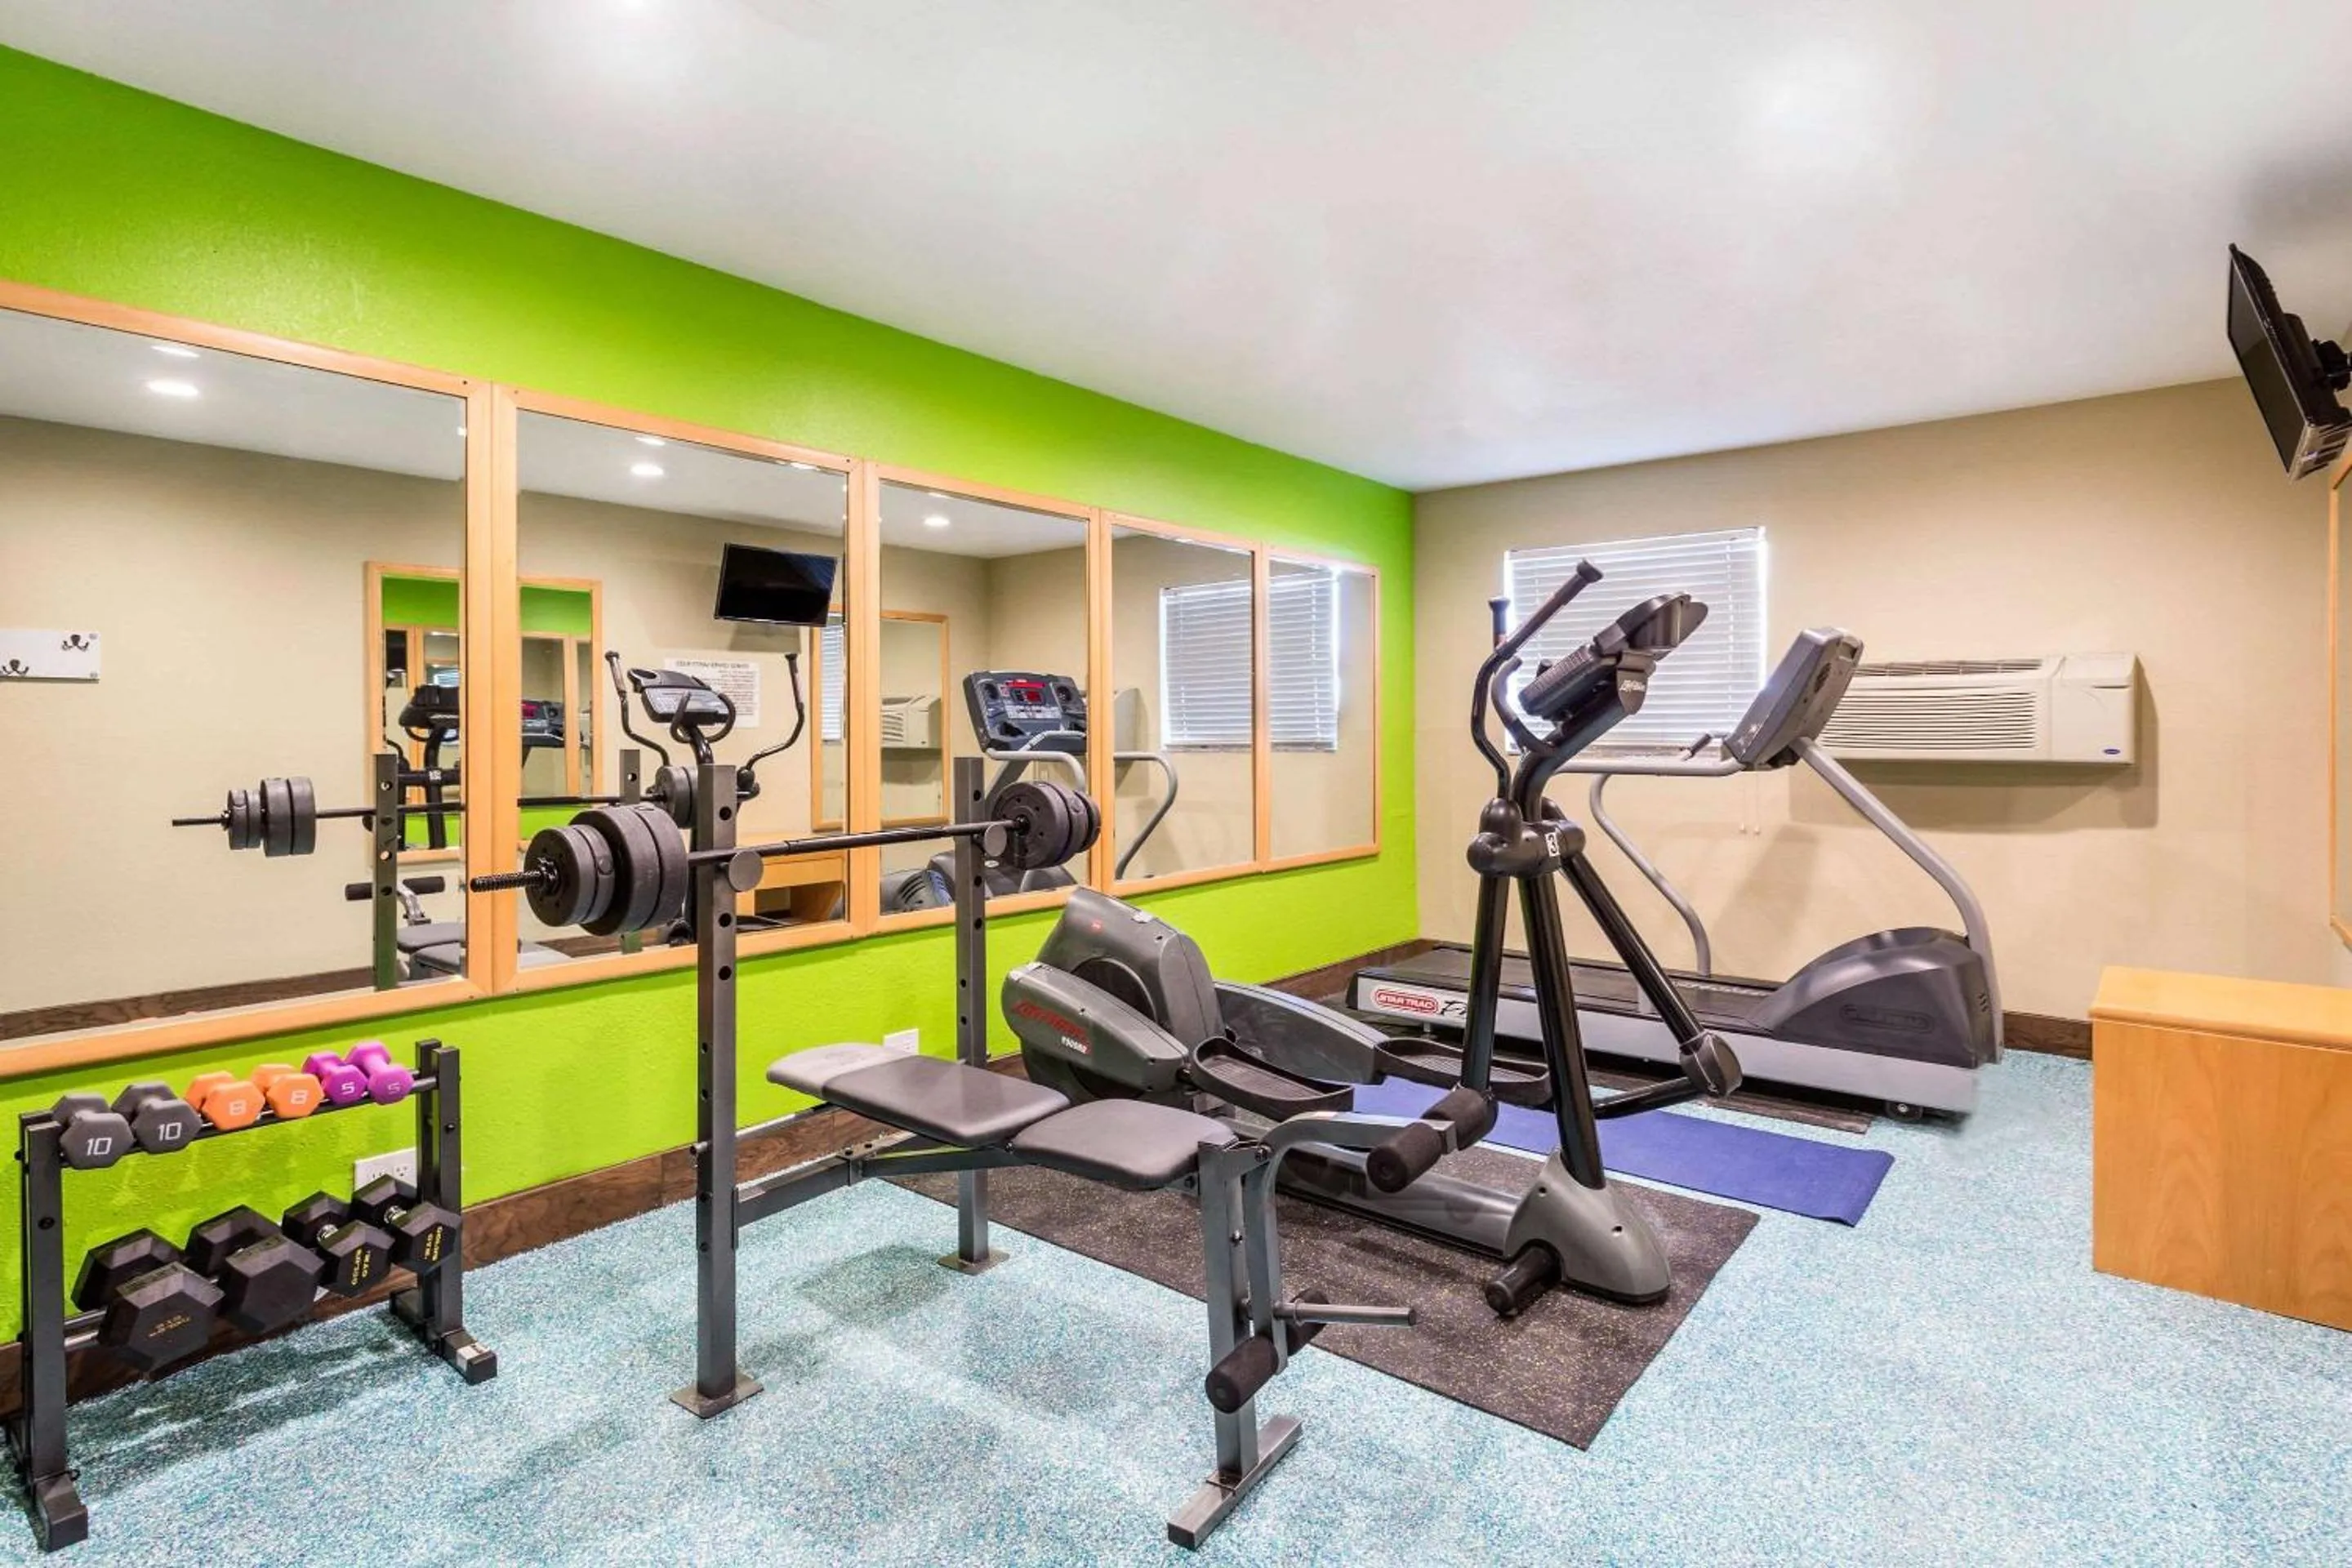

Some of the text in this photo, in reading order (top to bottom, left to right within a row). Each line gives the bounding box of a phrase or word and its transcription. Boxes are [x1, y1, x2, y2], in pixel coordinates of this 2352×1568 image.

[1379, 994, 1404, 1004] STAR
[1405, 997, 1434, 1009] TRAC
[341, 1080, 356, 1095] 5
[387, 1082, 401, 1095] 5
[290, 1089, 309, 1105] 8
[229, 1101, 247, 1116] 8
[158, 1122, 182, 1142] 10
[87, 1137, 113, 1156] 10
